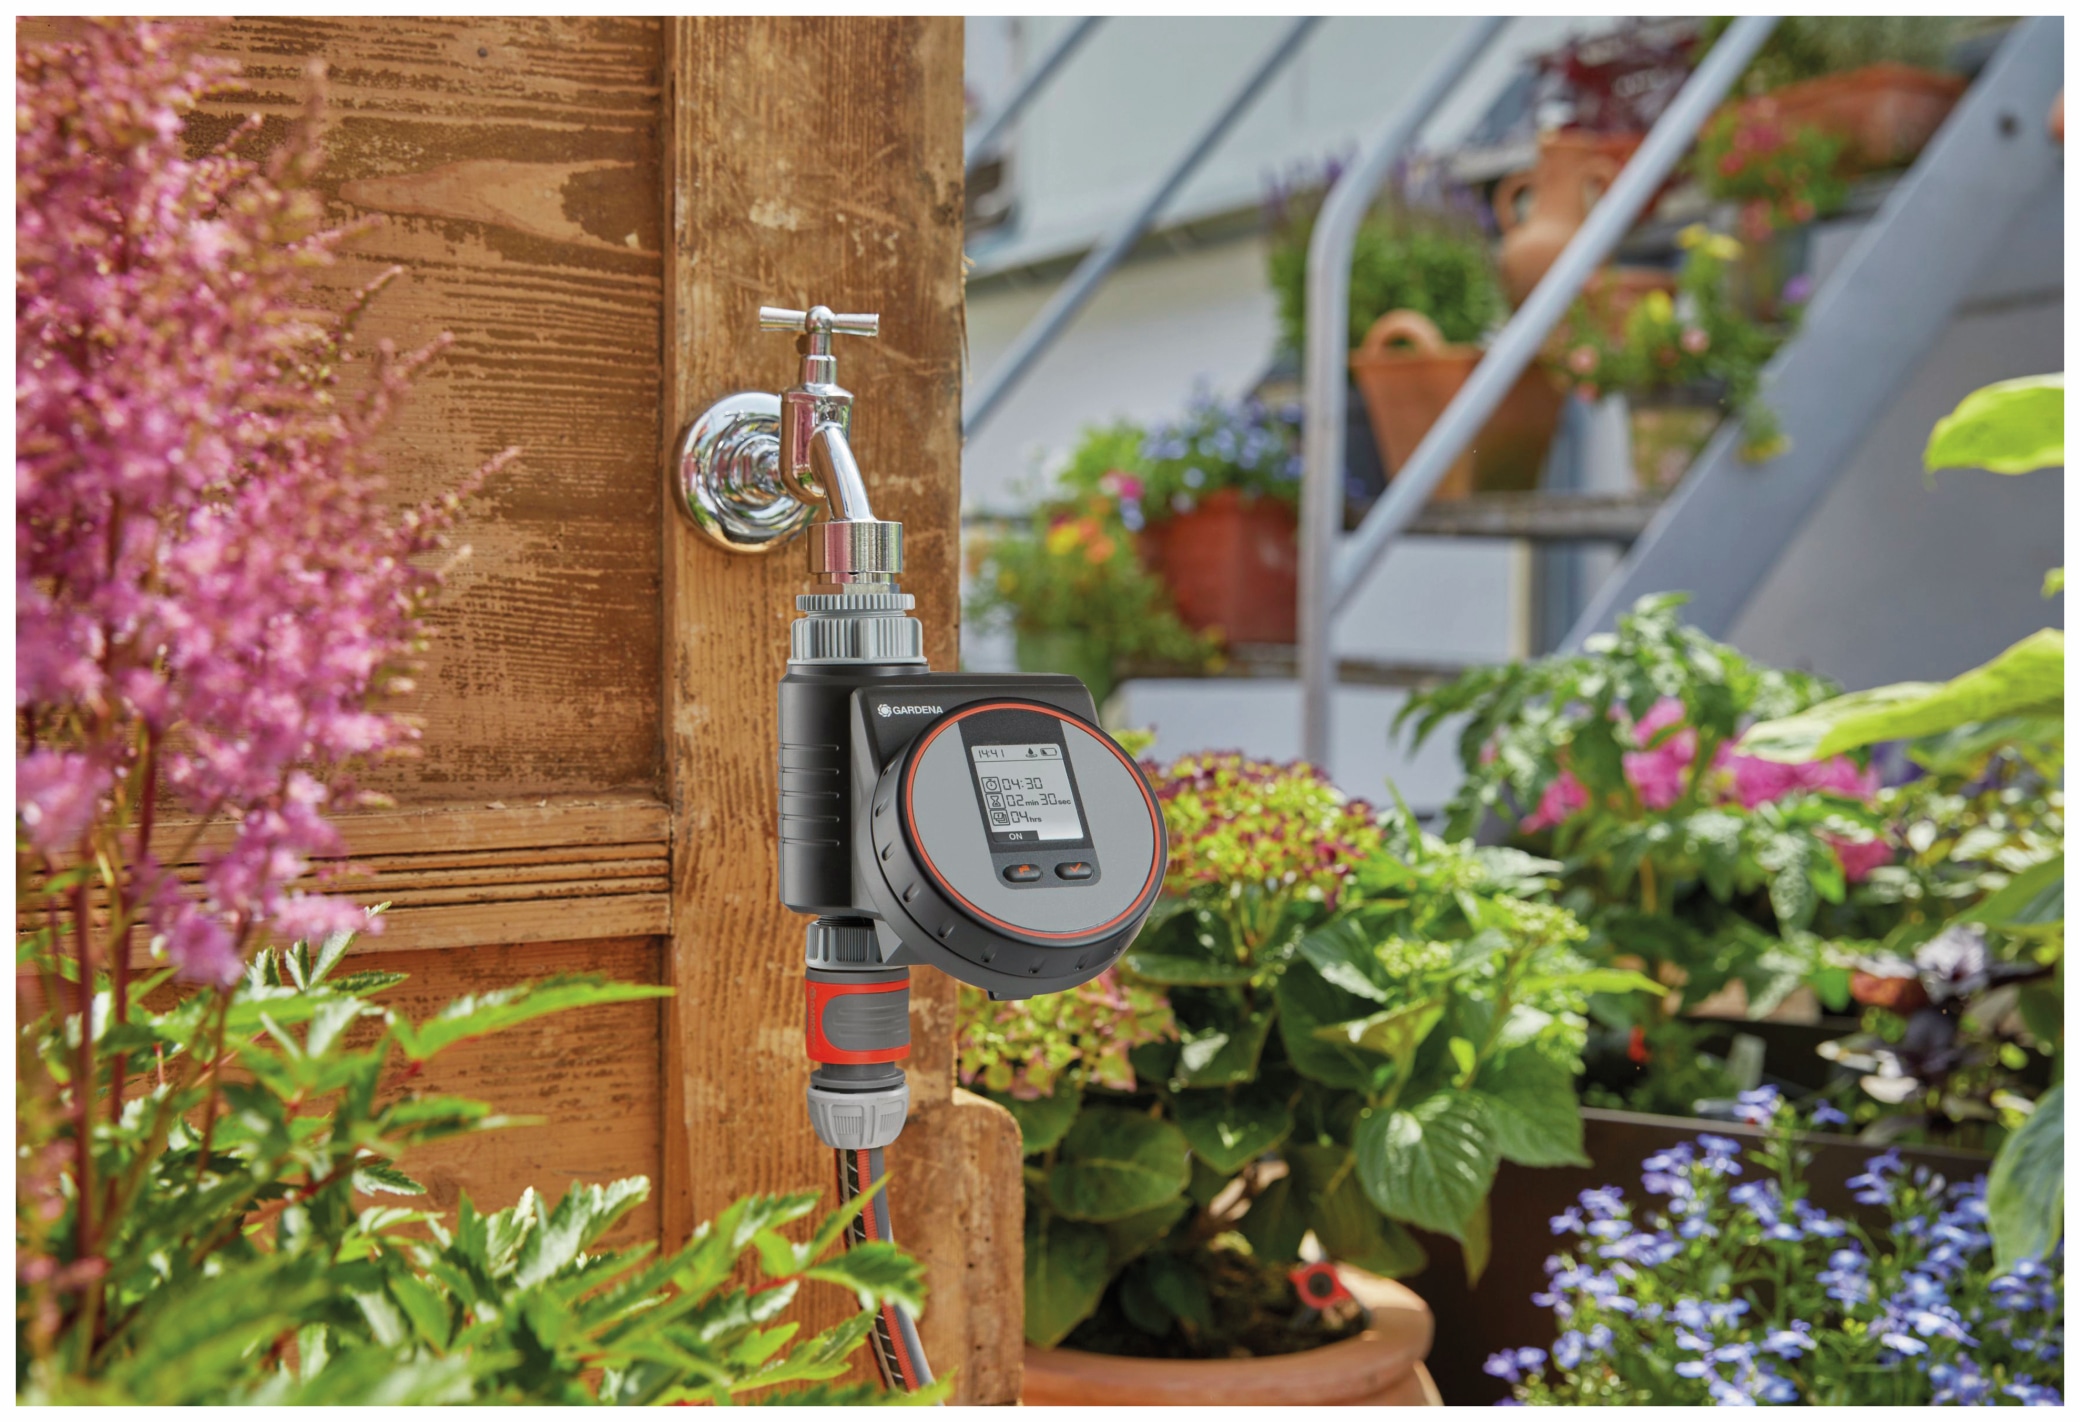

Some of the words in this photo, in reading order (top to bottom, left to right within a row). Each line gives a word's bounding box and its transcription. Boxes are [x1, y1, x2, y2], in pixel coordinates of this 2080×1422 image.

[892, 705, 944, 715] GARDENA
[978, 749, 1005, 759] 14:41
[1001, 777, 1043, 791] 04:30
[1008, 832, 1023, 840] ON
